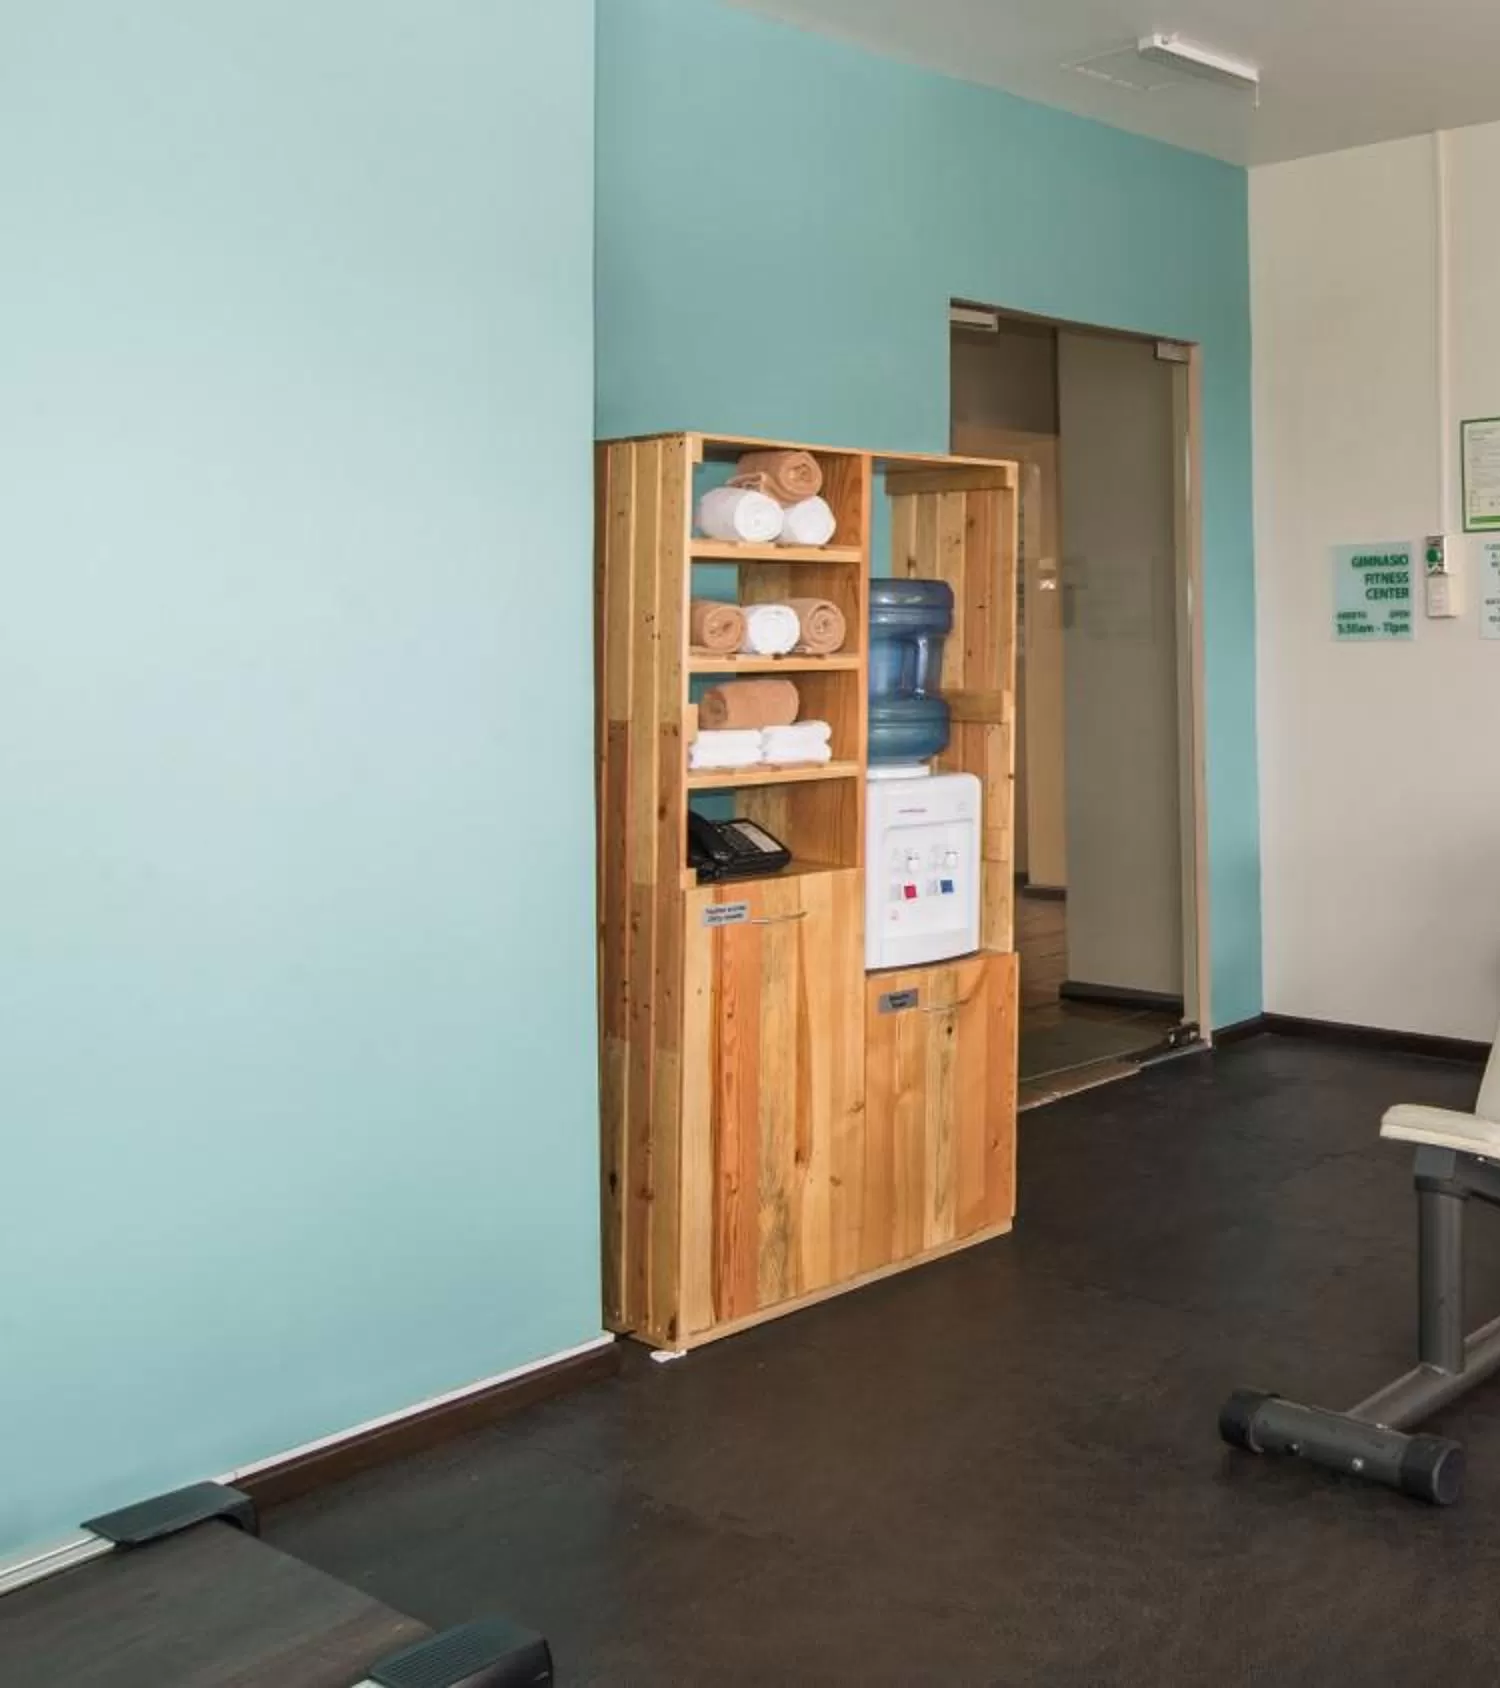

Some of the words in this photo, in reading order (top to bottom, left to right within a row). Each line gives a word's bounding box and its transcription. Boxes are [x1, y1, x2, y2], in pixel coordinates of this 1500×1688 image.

[1351, 554, 1409, 568] GIMNASIO
[1364, 572, 1409, 586] FITNESS
[1365, 587, 1409, 601] CENTER
